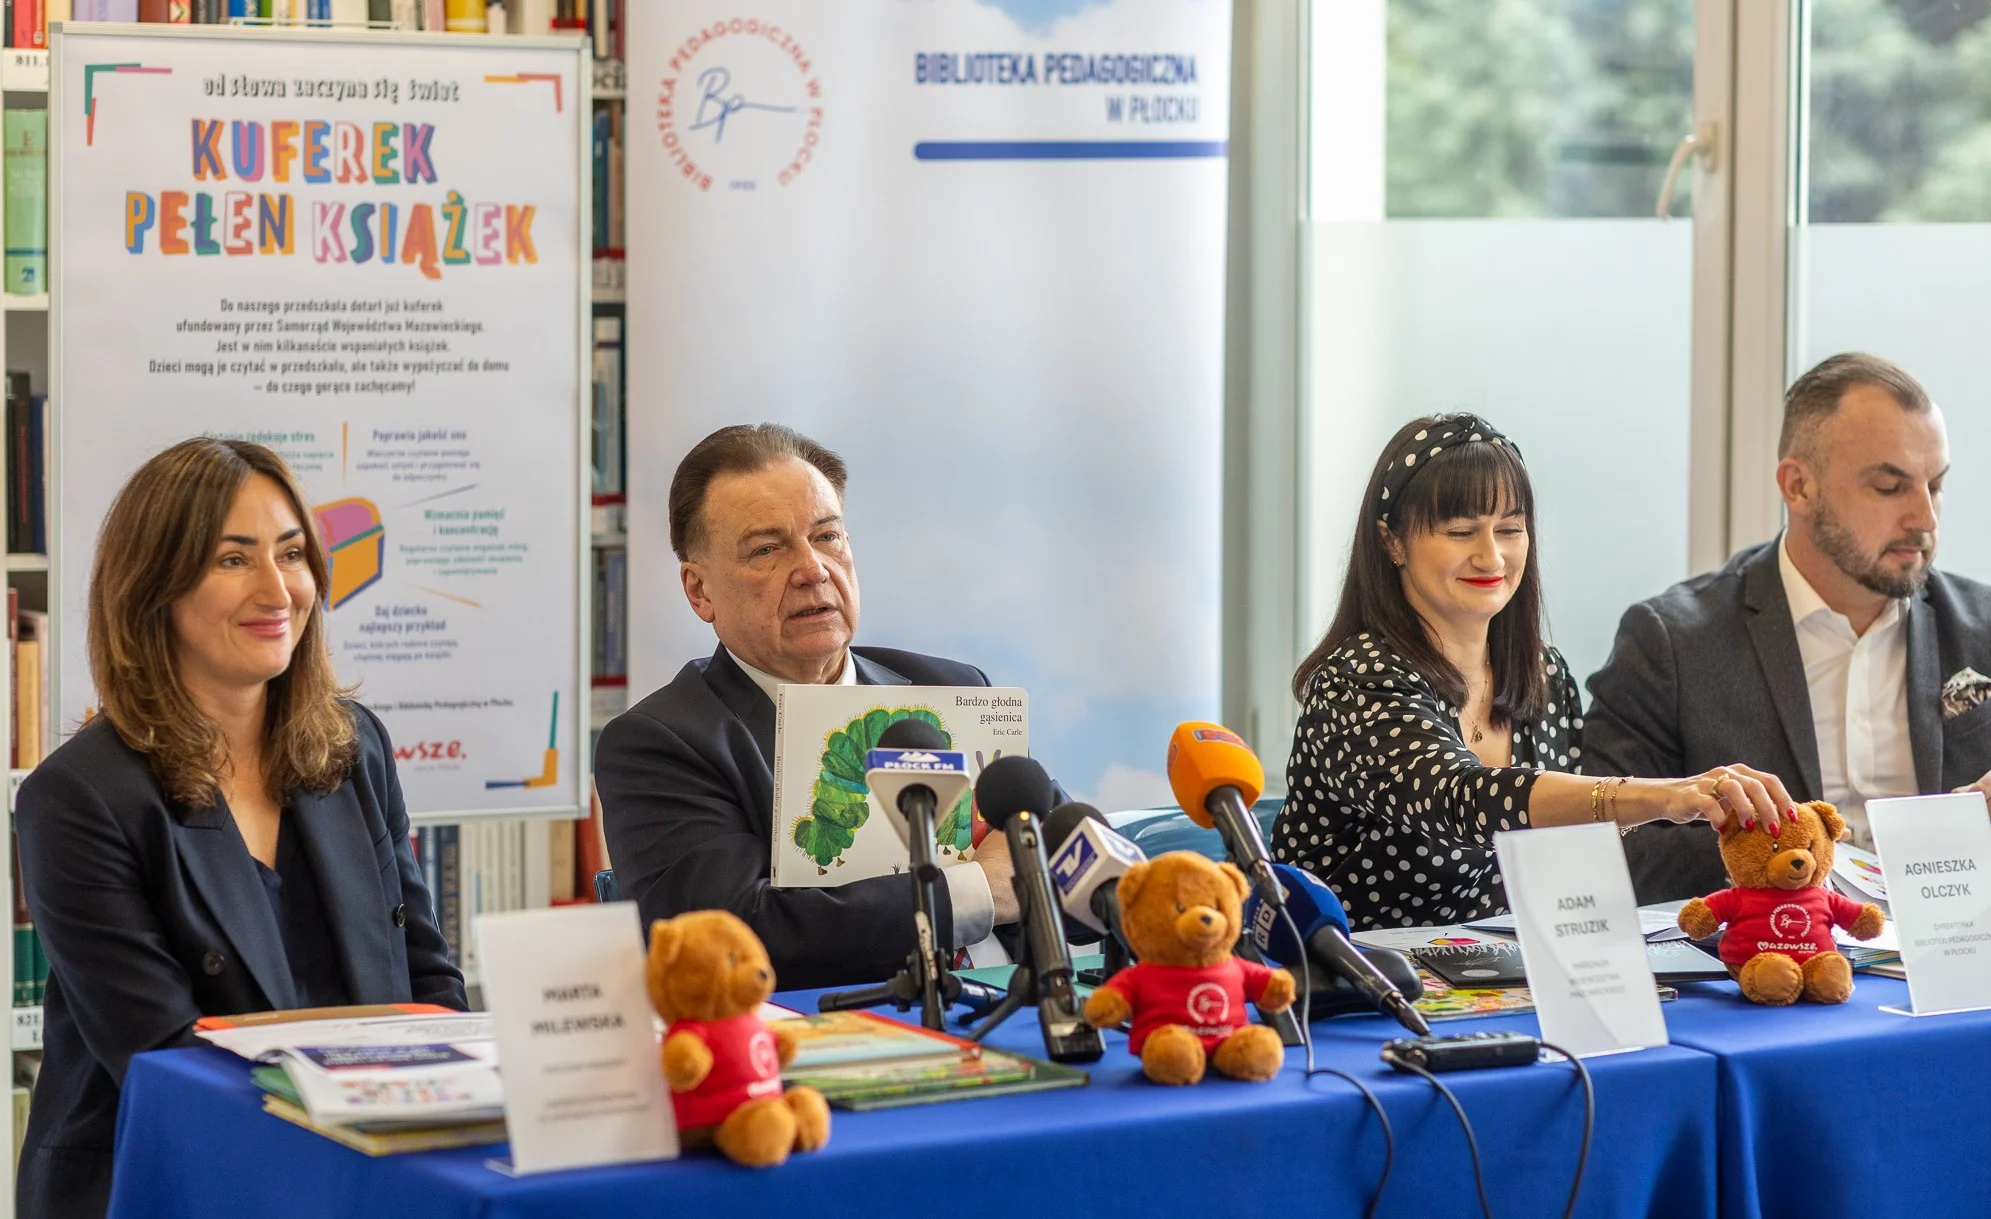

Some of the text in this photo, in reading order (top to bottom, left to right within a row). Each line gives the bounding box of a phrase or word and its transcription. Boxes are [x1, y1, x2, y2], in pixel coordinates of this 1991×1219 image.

[914, 52, 1199, 85] BIBLIOTEKA PEDAGOGICZNA
[203, 74, 460, 104] od słowa zaczyna się świat
[1105, 95, 1198, 124] W PŁOCKU
[191, 118, 438, 185] KUFEREK
[125, 190, 295, 256] PEŁEN
[311, 189, 539, 281] KSIĄŻEK
[220, 299, 443, 316] Do naszego przedszkola dotarł już kuferek
[176, 319, 241, 335] ufundowany
[245, 321, 273, 335] przez
[277, 318, 329, 335] Samorząd
[332, 318, 402, 335] Województwa
[216, 340, 238, 352] Jest
[253, 340, 273, 352] nim
[277, 339, 337, 352] kilkanaście
[341, 340, 406, 355] wspaniałych
[149, 359, 181, 373] Dzieci
[185, 363, 214, 376] mogą
[217, 360, 227, 376] je
[231, 358, 265, 376] czytać
[351, 361, 366, 373] ale
[370, 360, 398, 373] także
[403, 357, 464, 375] wypożyczać
[467, 360, 479, 372] do
[482, 359, 509, 372] domu
[266, 381, 278, 393] do
[282, 383, 312, 395] czego
[315, 383, 351, 396] gorąco
[354, 380, 416, 395] zachęcamy!
[955, 696, 1022, 709] Bardzo głodna
[979, 711, 1022, 725] gąsienica
[993, 728, 1022, 736] Eric Carle
[884, 761, 931, 770] PŁOCK
[1905, 859, 1977, 876] AGNIESZKA
[1921, 883, 1972, 899] OLCZYK
[1557, 895, 1597, 911] ADAM
[1555, 919, 1610, 937] STRUZIK
[543, 985, 602, 1001] MARTA
[531, 1013, 624, 1035] MILEWSKA
